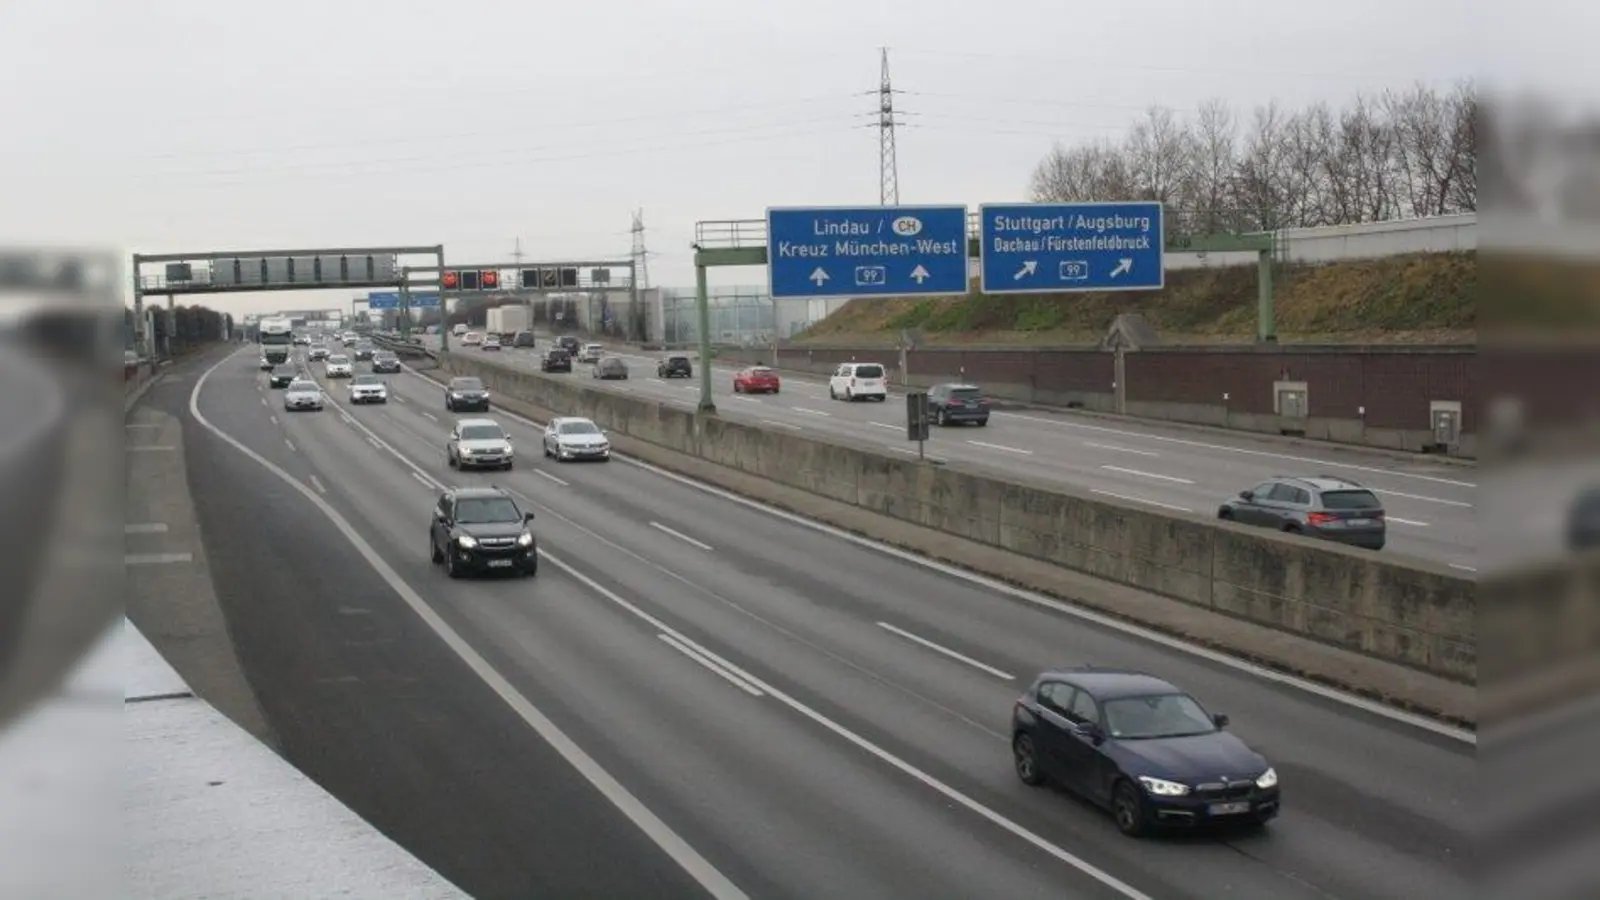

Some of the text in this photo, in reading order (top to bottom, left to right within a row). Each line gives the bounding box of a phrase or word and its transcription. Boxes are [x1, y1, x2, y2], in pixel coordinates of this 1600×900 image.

[814, 219, 869, 235] Lindau
[898, 220, 917, 232] CH
[779, 239, 957, 257] Kreuz München-West
[863, 269, 878, 281] 99
[1066, 264, 1080, 276] 99
